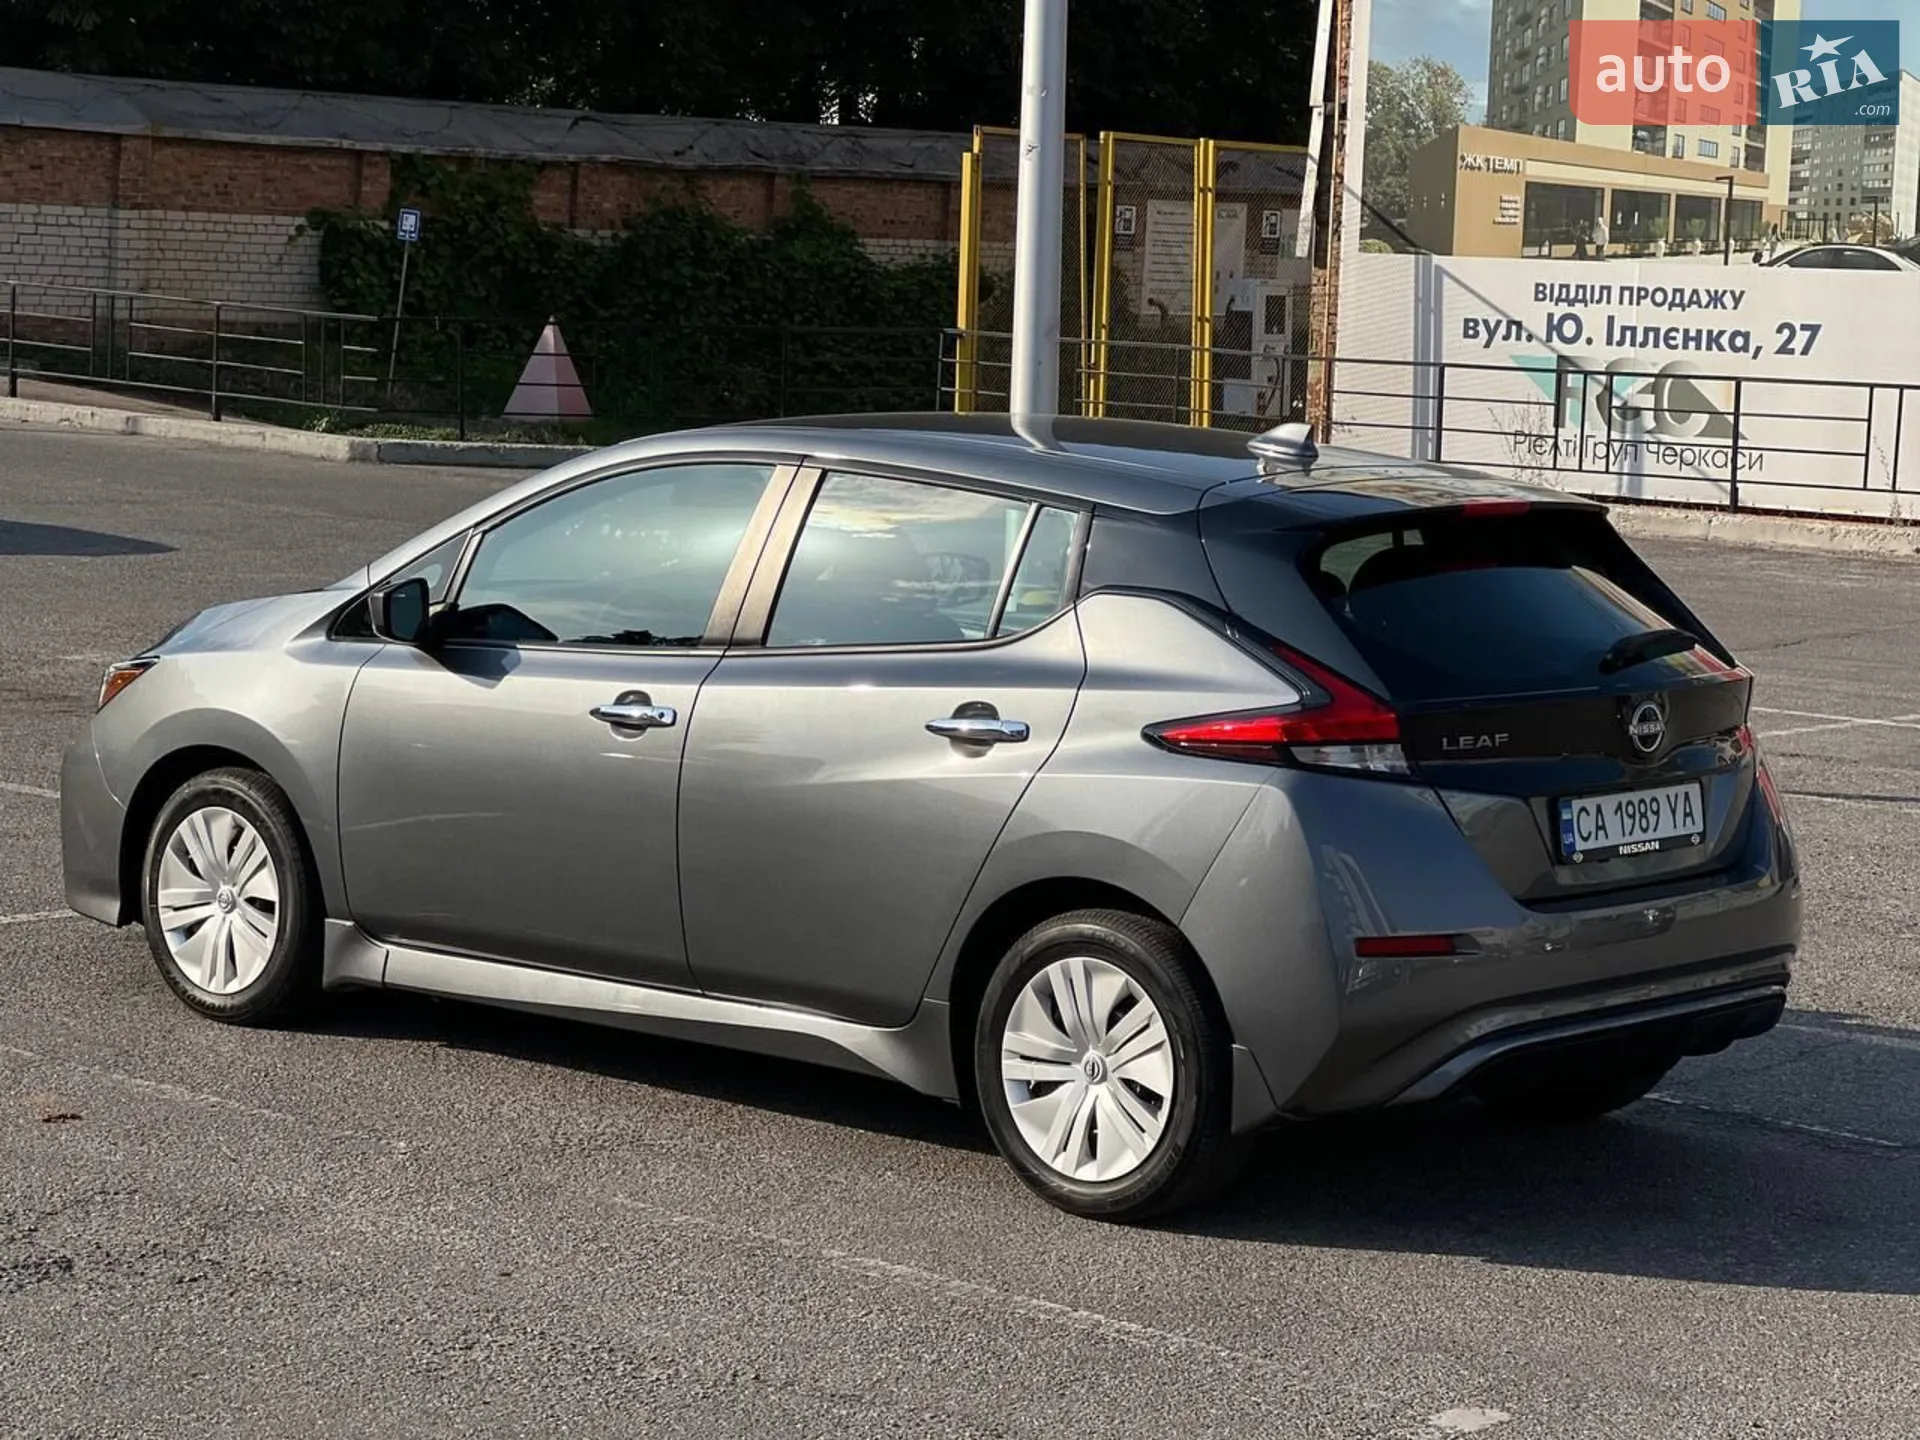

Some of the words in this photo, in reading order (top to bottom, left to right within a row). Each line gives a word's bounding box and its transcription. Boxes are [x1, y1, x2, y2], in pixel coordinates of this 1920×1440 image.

[1534, 282, 1612, 306] ВІДДІЛ
[1618, 286, 1746, 312] ПРОДАЖУ
[1462, 316, 1533, 349] вул.
[1545, 312, 1594, 346] Ю.
[1605, 315, 1763, 360] Іллєнка,
[1773, 322, 1822, 356] 27
[1584, 434, 1639, 466] Груп
[1645, 440, 1764, 471] Черкаси
[1442, 733, 1510, 750] LEAF
[1576, 804, 1609, 842] CA
[1614, 796, 1661, 838] 1989
[1666, 791, 1696, 829] YA
[1618, 841, 1660, 855] NISSAN
